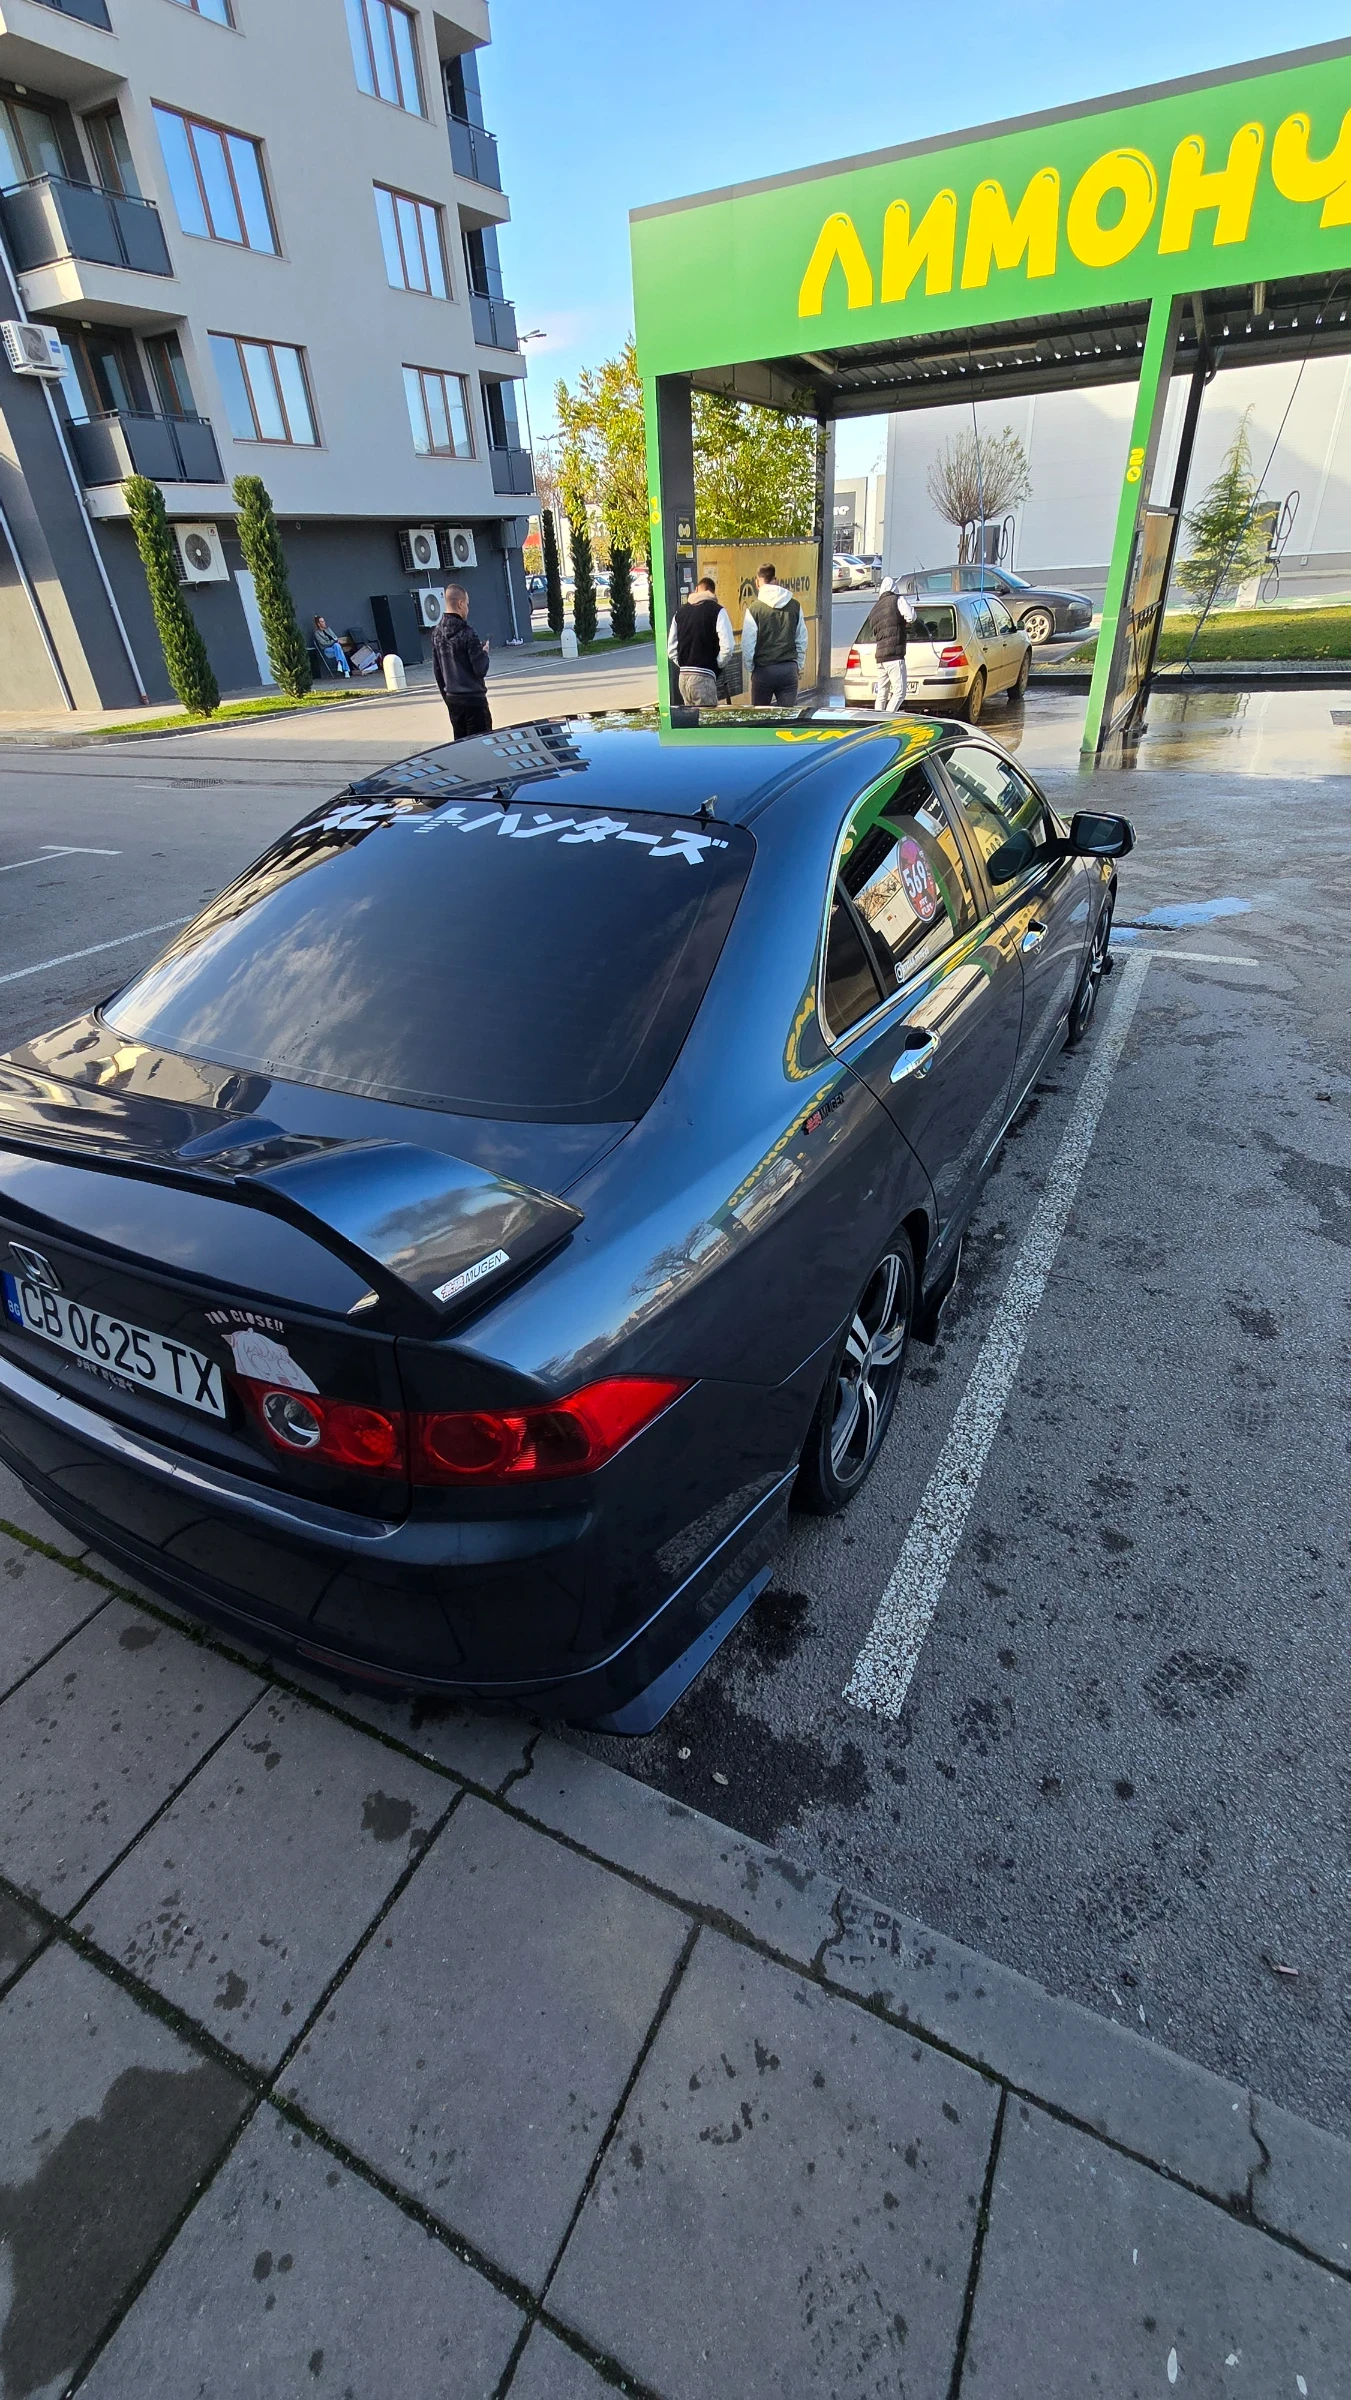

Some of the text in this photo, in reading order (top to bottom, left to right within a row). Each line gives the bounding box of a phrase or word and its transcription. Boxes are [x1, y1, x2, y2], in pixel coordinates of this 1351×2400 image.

[902, 860, 928, 898] 569
[465, 1252, 502, 1284] MUGEN
[7, 1299, 21, 1317] BG
[204, 1309, 229, 1325] TOO
[21, 1281, 63, 1338] CB
[68, 1303, 156, 1381] 0625
[161, 1341, 220, 1411] TX
